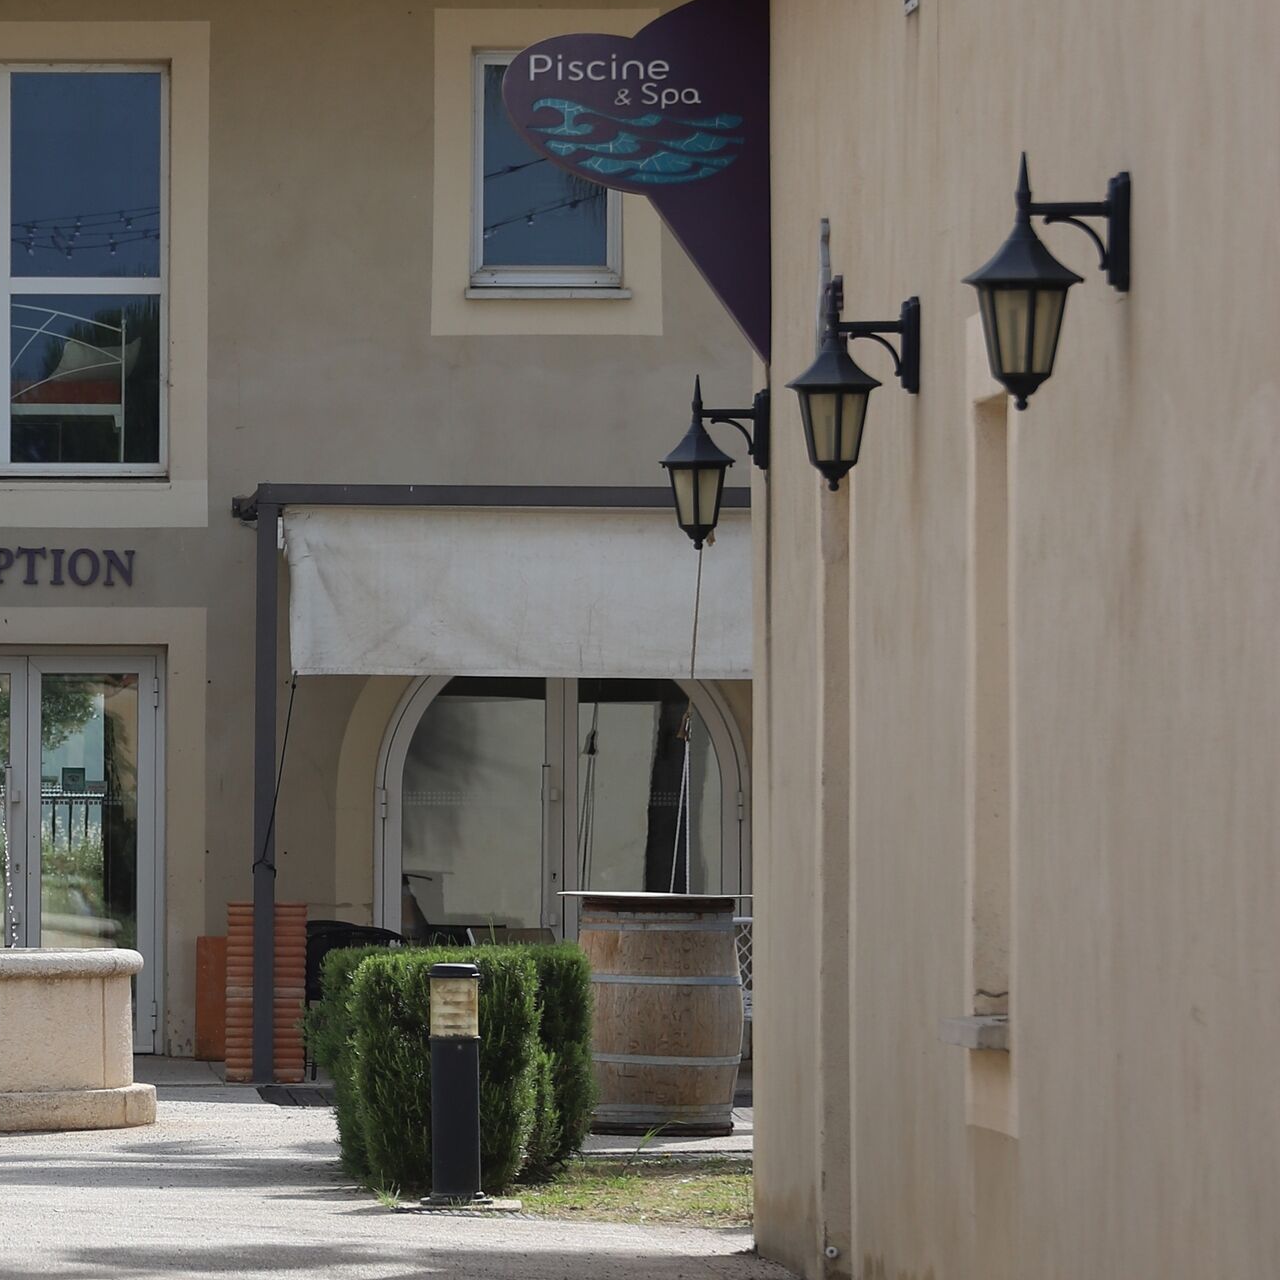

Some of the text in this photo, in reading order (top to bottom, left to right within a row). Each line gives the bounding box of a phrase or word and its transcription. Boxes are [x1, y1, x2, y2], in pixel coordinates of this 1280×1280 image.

[528, 53, 670, 82] Piscine
[613, 82, 702, 108] & Spa
